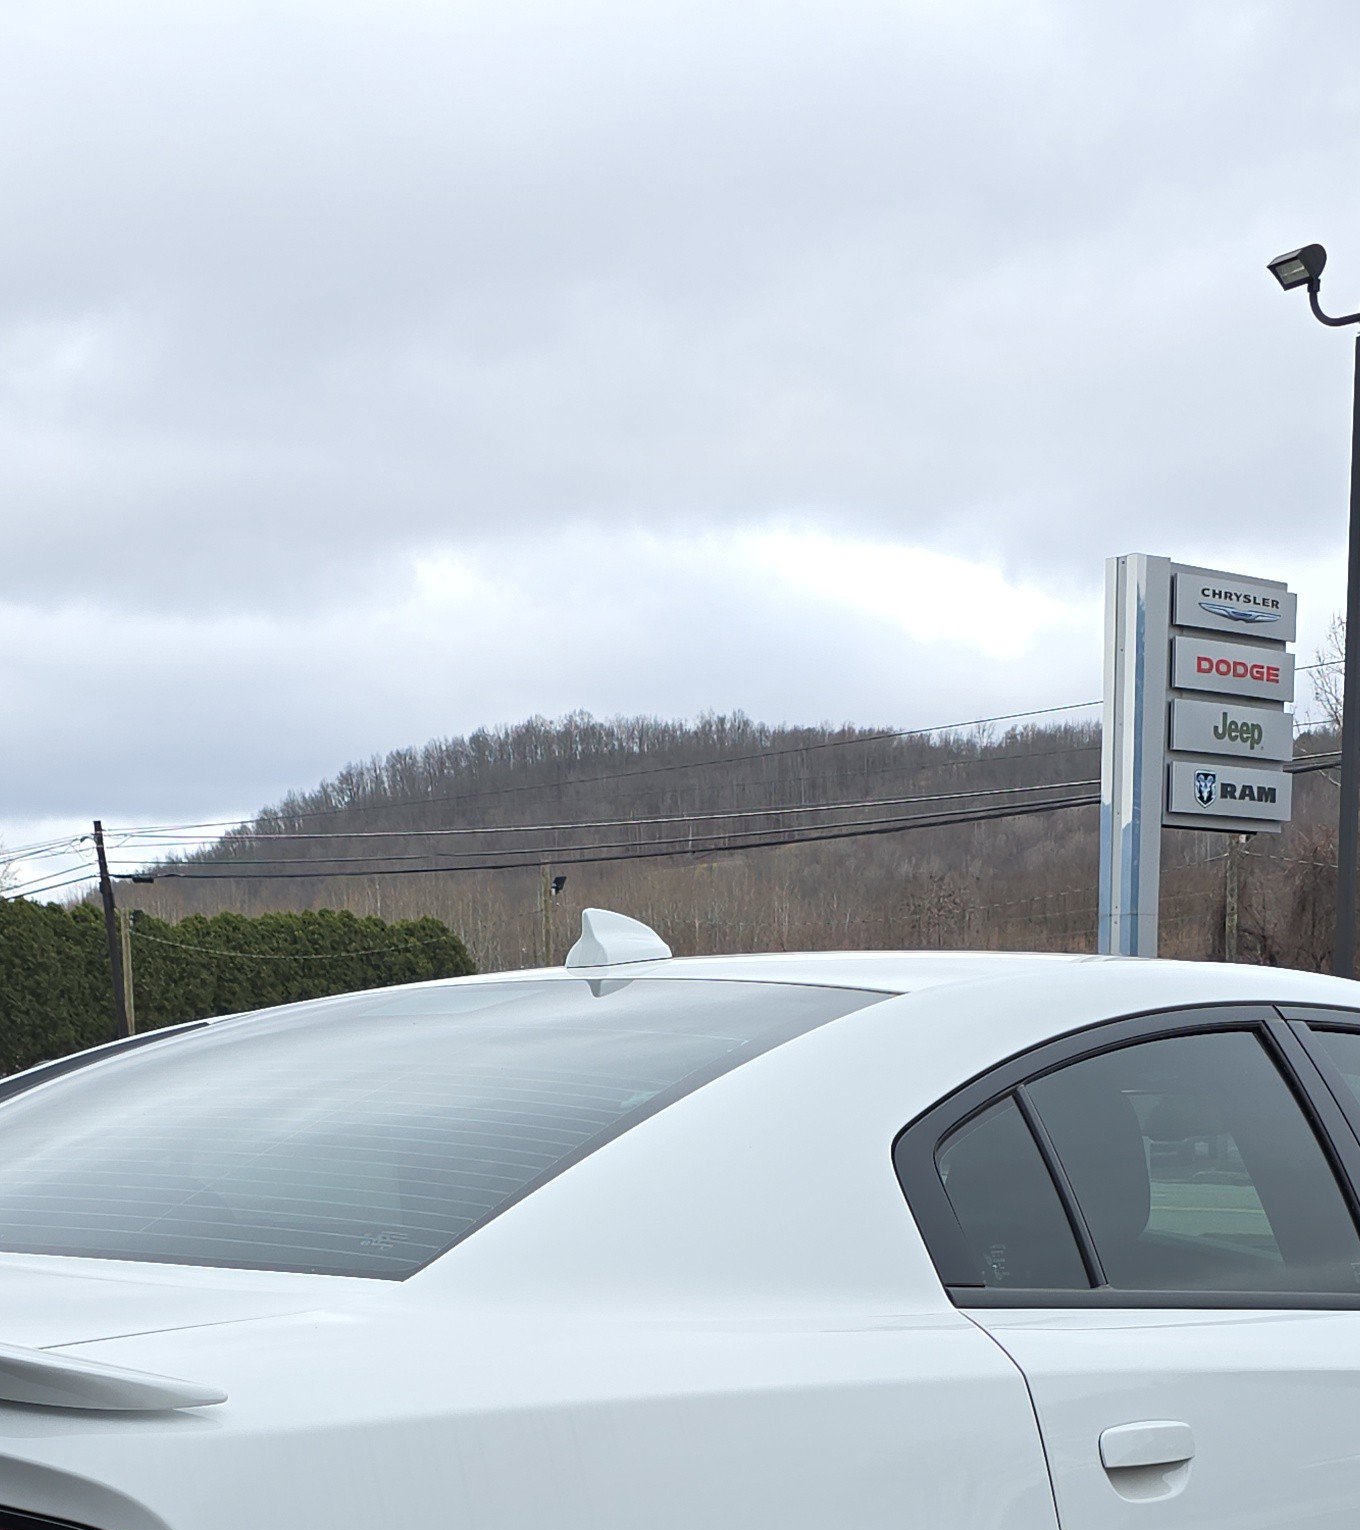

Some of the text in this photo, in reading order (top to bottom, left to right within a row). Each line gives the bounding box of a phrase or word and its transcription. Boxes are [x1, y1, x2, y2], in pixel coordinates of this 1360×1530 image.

[1201, 587, 1280, 610] CHRYSLER
[1196, 656, 1280, 684] DODGE
[1213, 712, 1263, 750] Jeep
[1220, 782, 1277, 804] RAM
